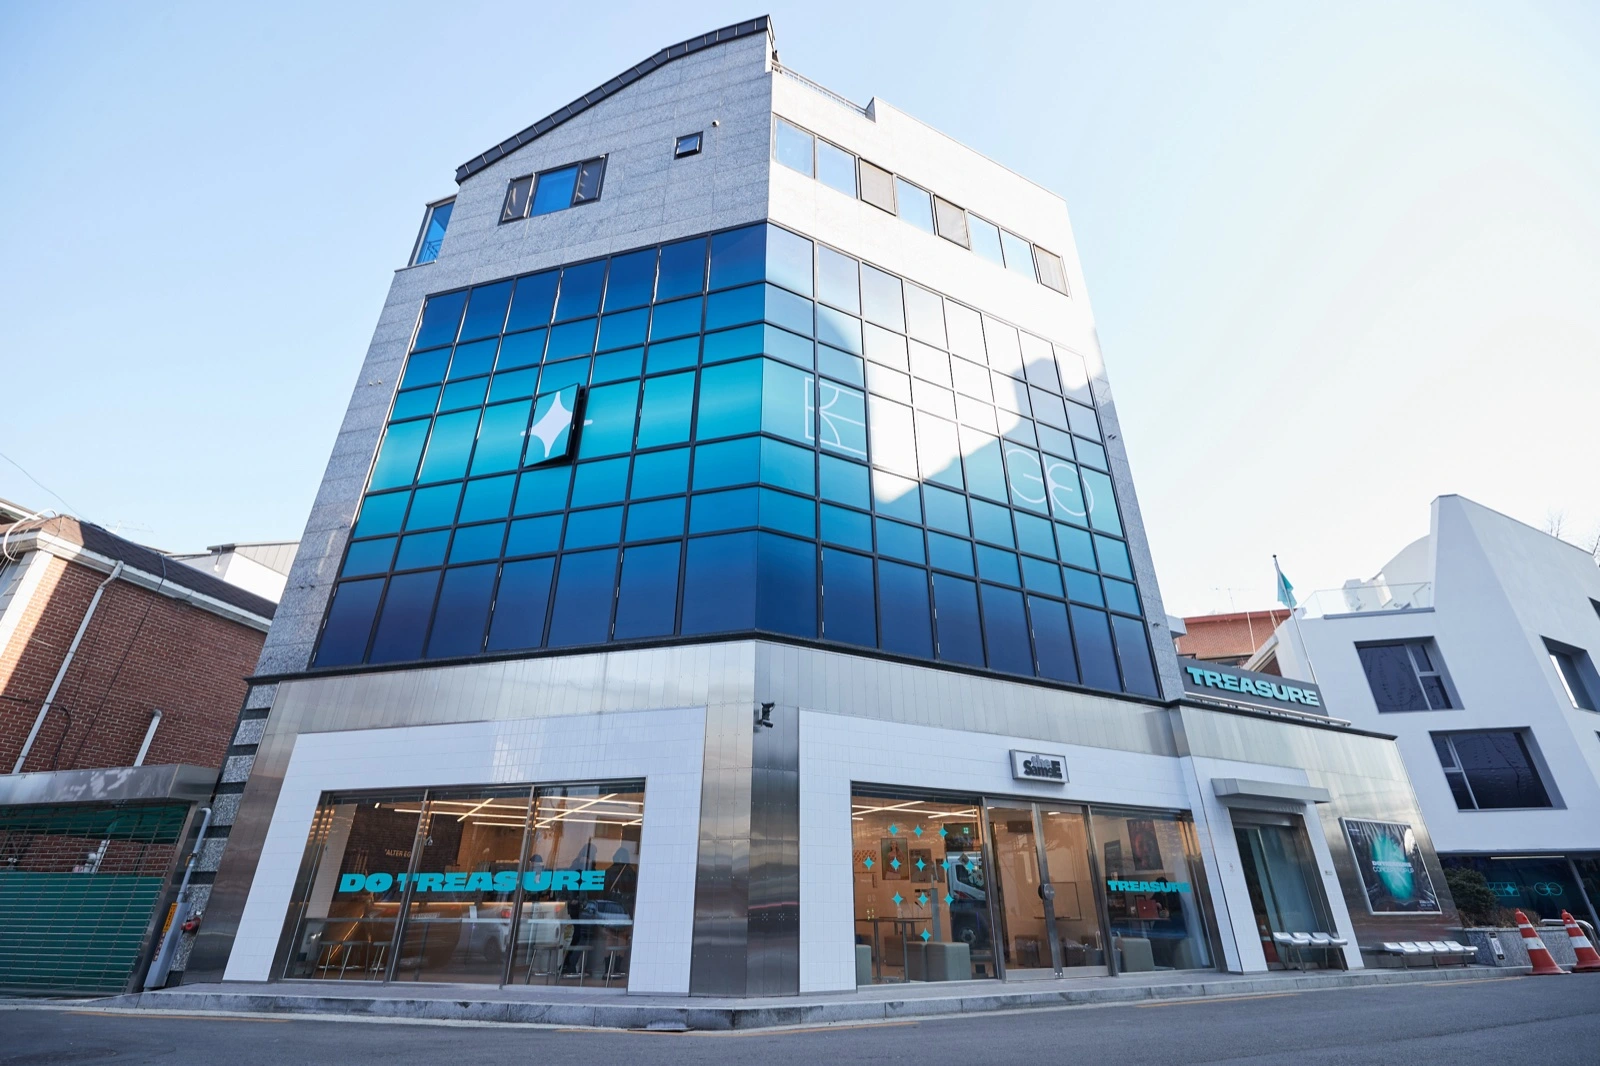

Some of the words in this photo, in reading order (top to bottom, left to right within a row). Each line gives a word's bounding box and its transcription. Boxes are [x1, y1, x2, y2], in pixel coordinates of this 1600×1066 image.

[1186, 666, 1321, 707] TREASURE
[338, 873, 393, 892] DO
[397, 870, 606, 892] TREASURE
